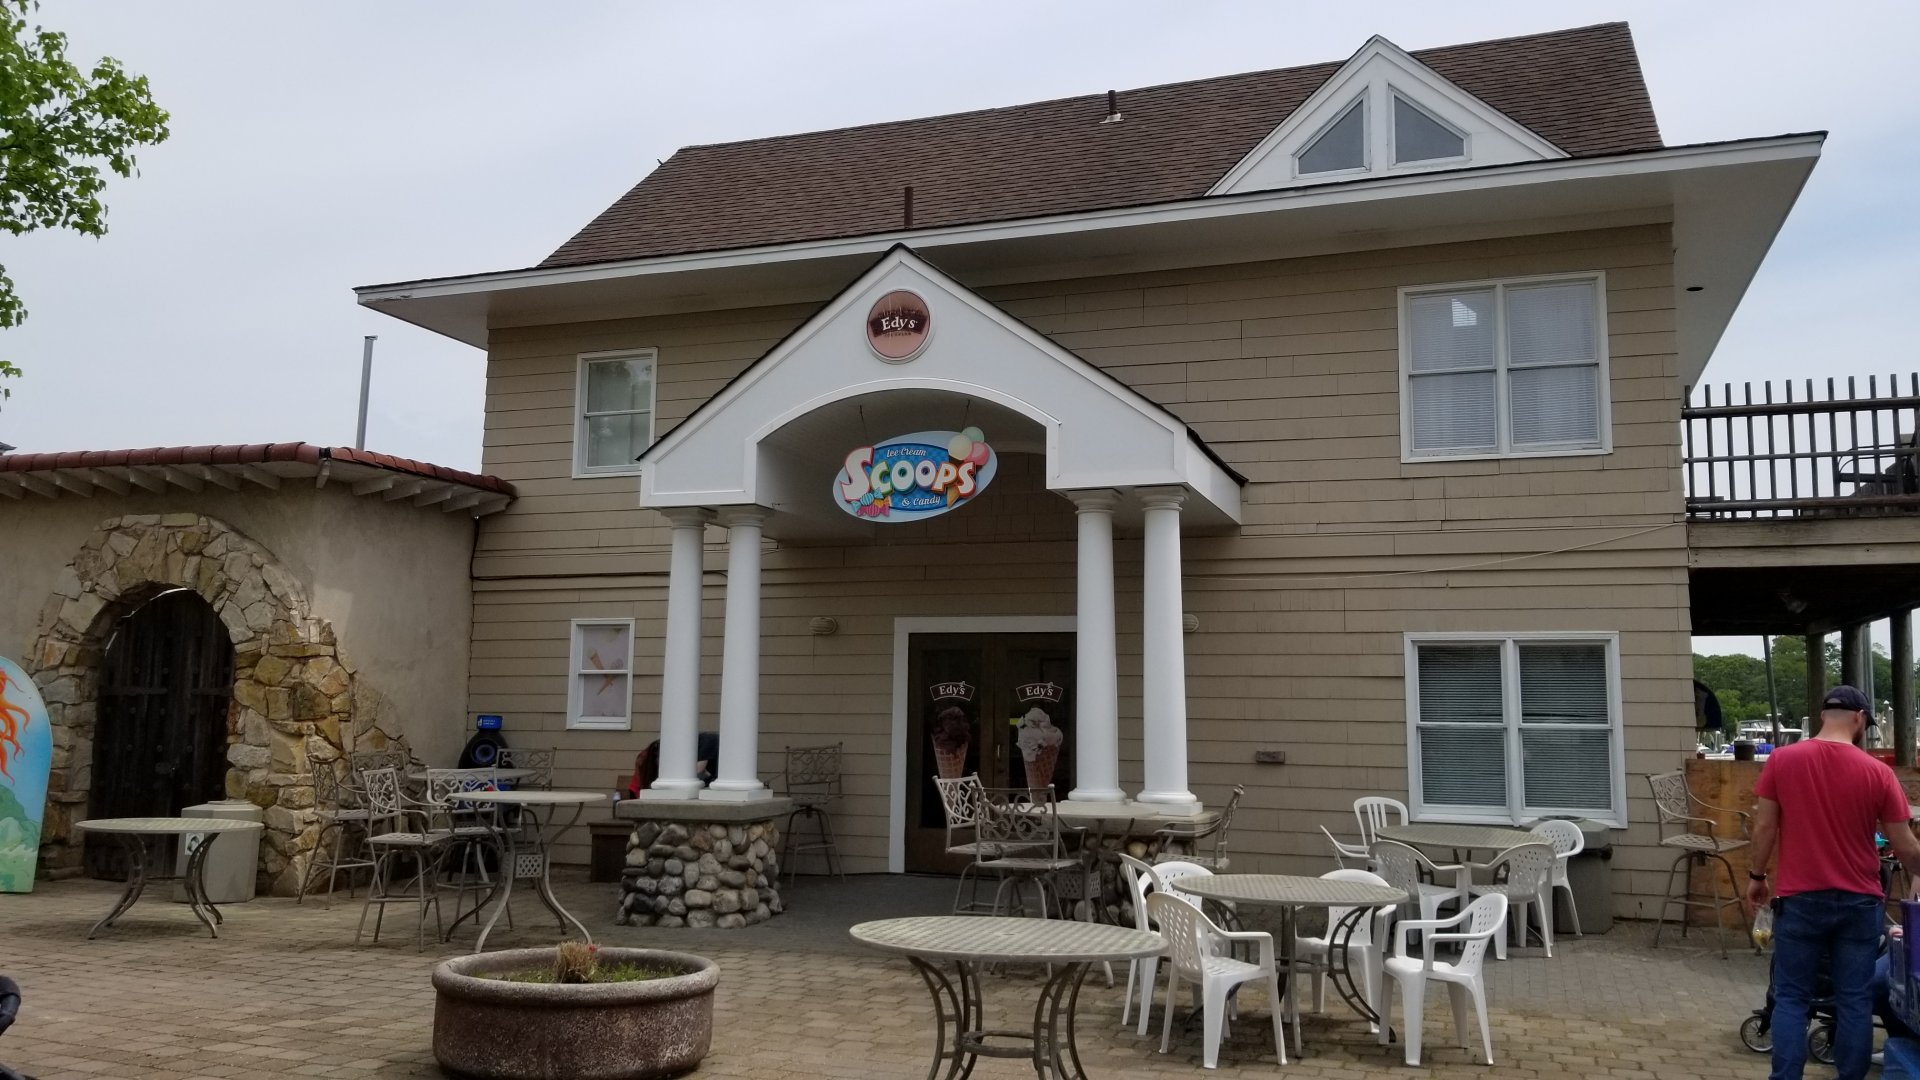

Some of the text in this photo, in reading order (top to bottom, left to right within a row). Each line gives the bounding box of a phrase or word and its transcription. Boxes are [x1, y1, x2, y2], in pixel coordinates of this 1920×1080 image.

[880, 316, 916, 331] Edys
[886, 447, 927, 458] Ice Cream
[839, 446, 976, 502] SCOOPS
[901, 495, 941, 507] & Candy
[939, 683, 966, 696] Edy's
[1025, 685, 1054, 698] Edy's
